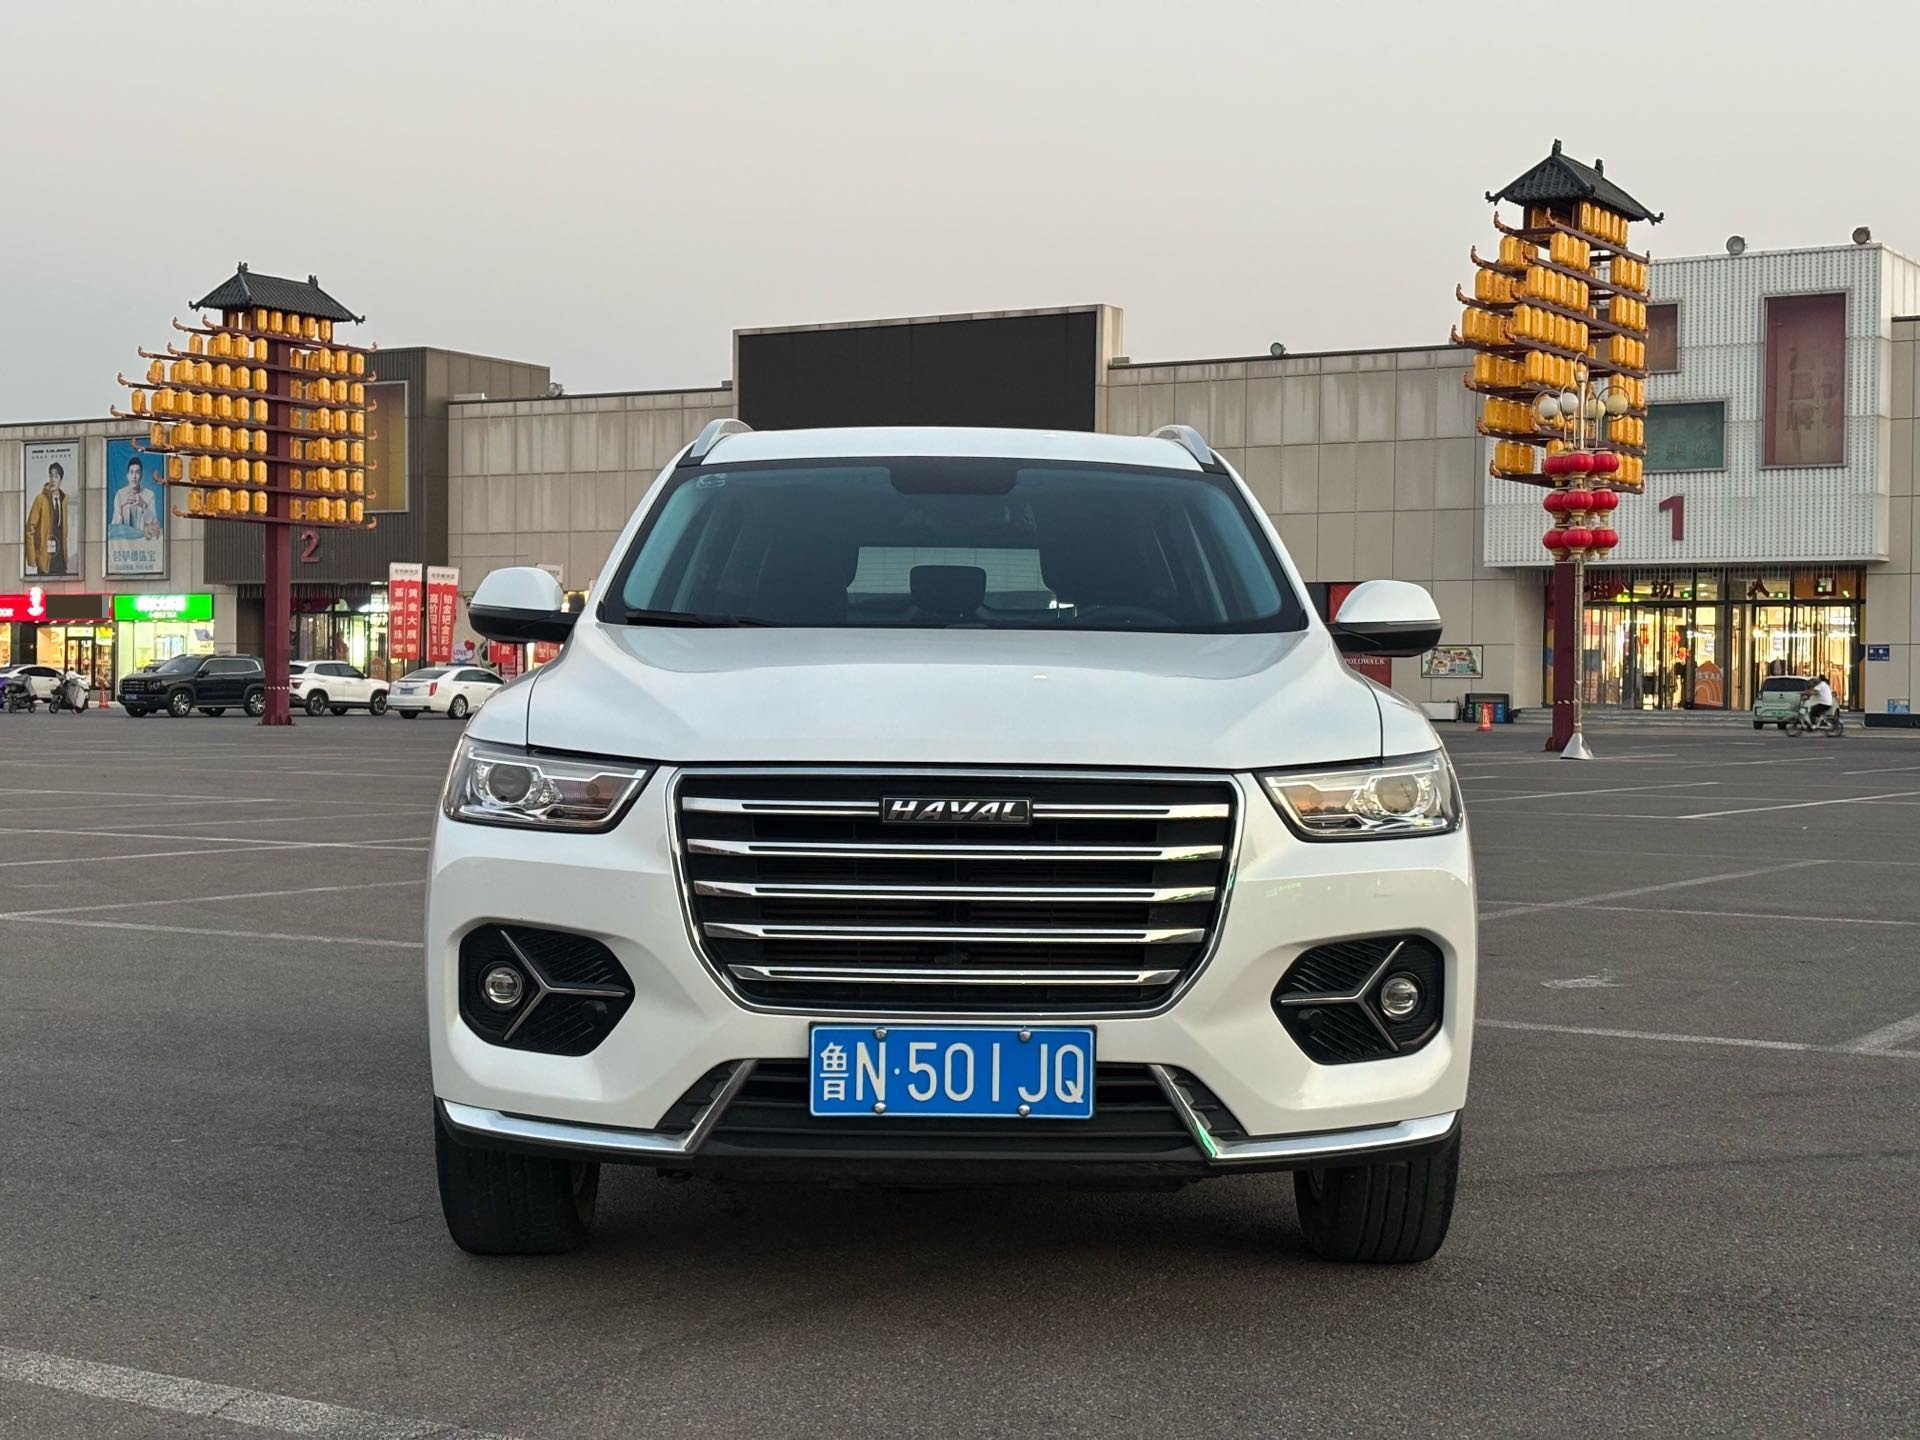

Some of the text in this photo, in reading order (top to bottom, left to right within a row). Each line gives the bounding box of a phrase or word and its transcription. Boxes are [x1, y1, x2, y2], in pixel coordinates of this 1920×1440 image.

[1659, 496, 1684, 541] 1
[301, 530, 320, 563] 2
[887, 800, 1025, 821] HAVAL
